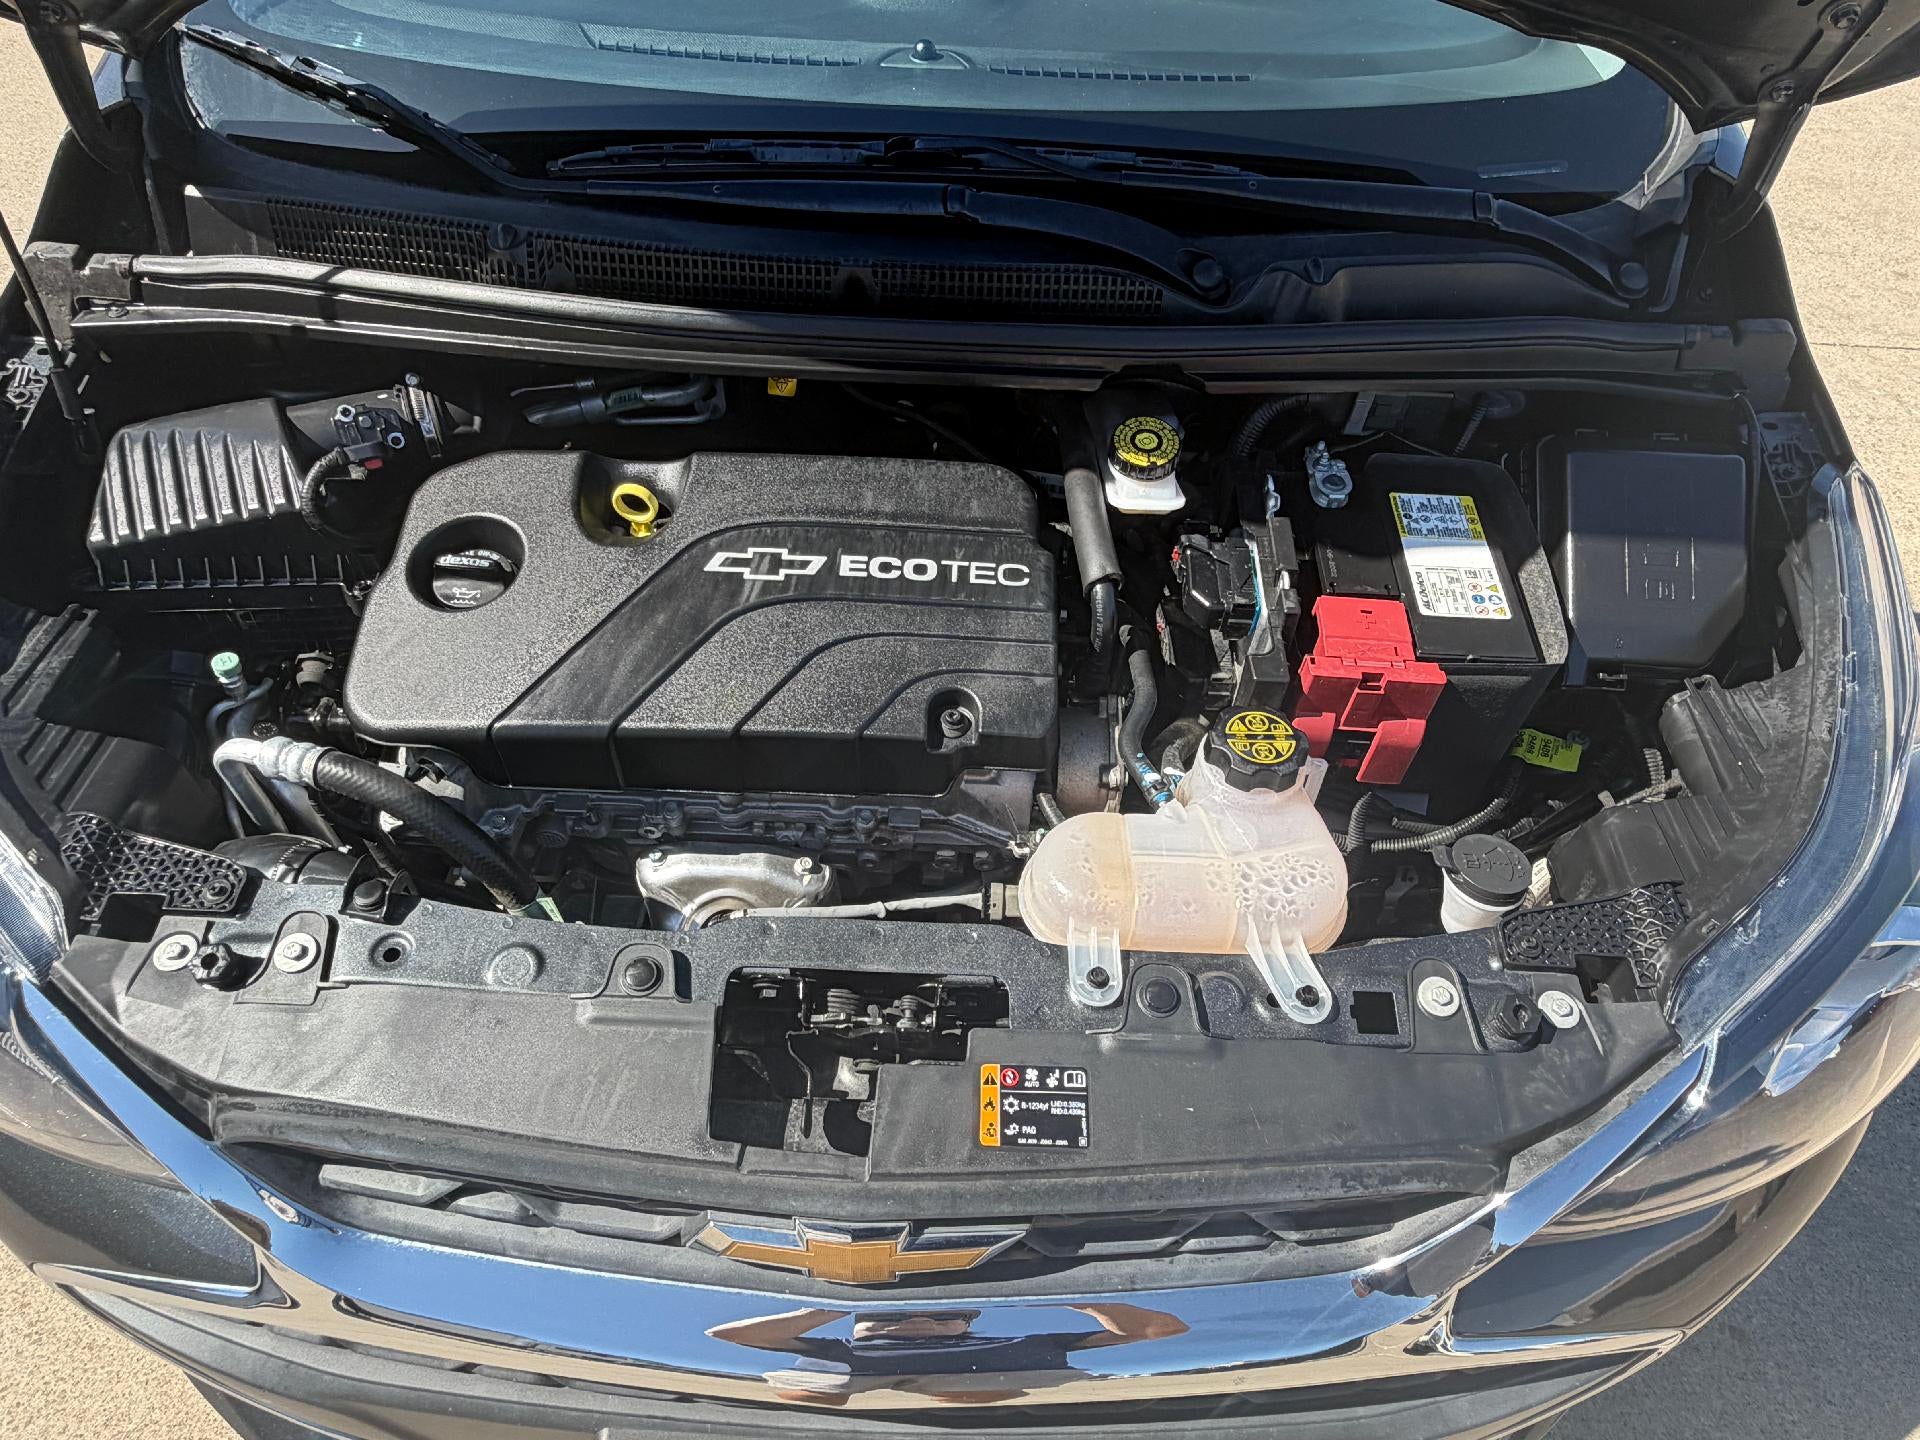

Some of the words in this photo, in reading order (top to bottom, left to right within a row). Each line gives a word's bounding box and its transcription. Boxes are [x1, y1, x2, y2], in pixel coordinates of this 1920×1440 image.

[439, 554, 490, 567] dexos
[839, 554, 1030, 587] ECOTEC
[1024, 1080, 1040, 1088] AUTO
